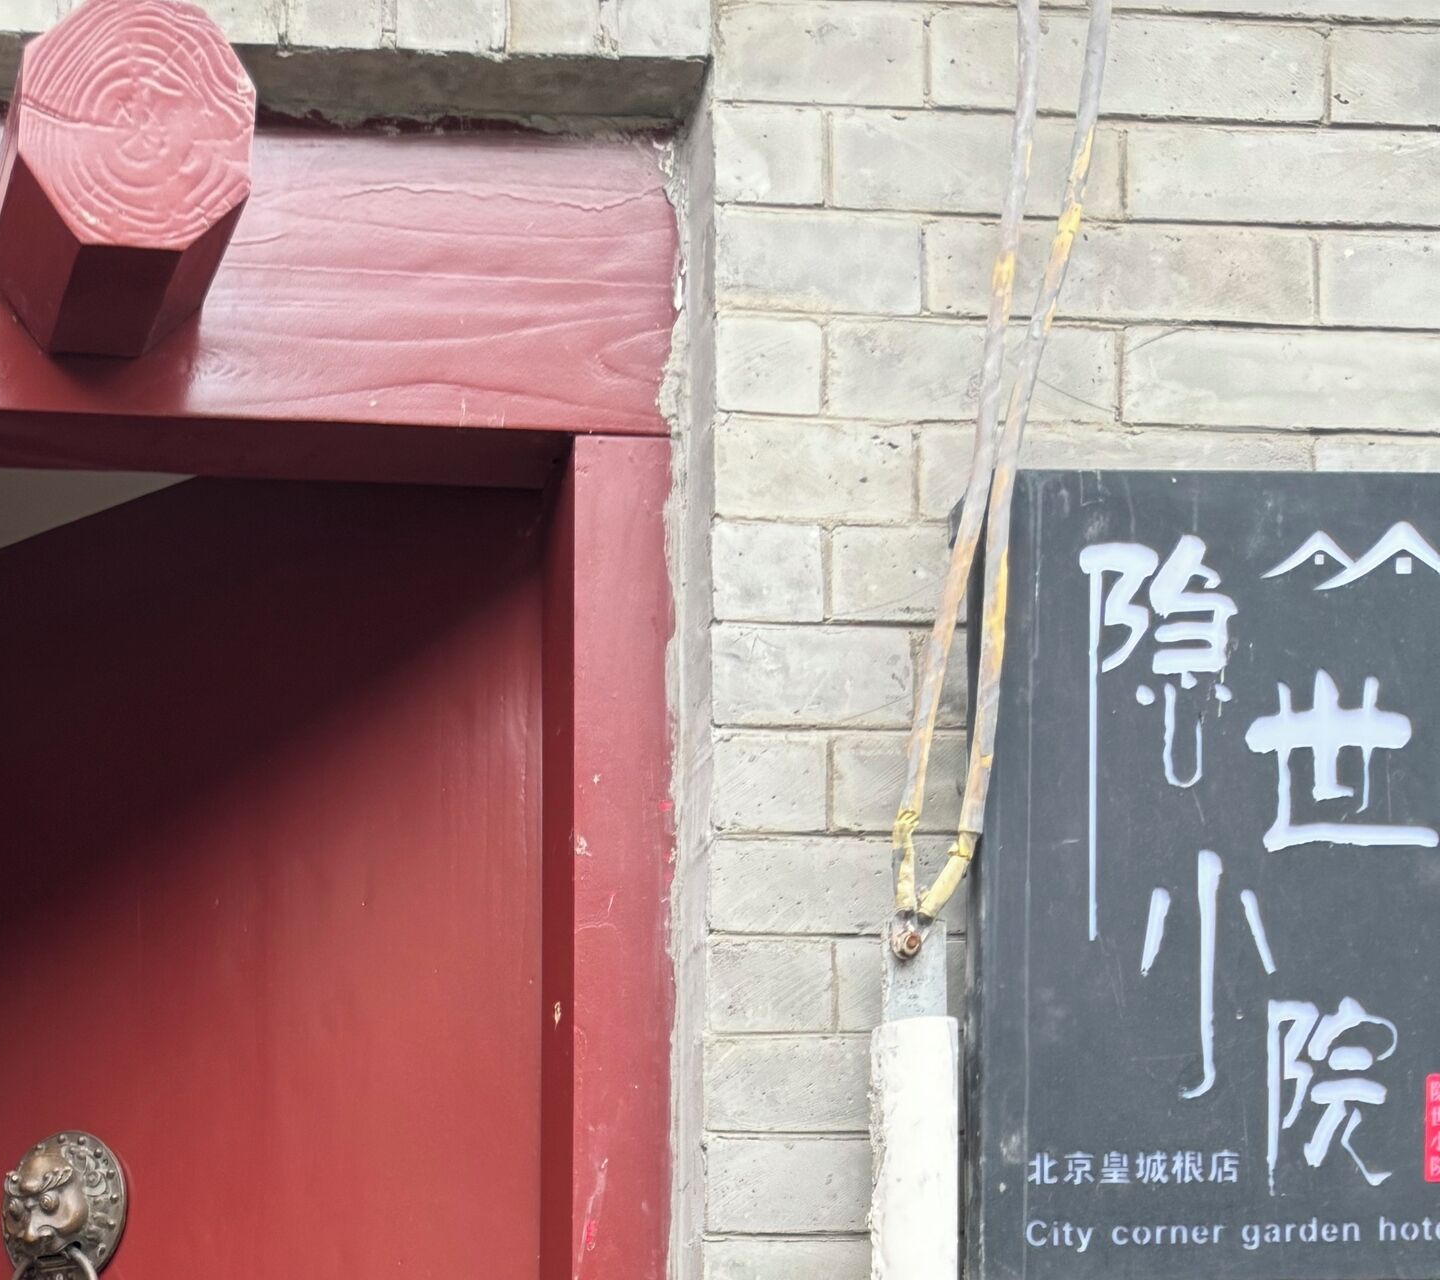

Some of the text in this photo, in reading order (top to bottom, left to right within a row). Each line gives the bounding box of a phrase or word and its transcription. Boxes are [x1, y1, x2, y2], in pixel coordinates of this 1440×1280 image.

[1027, 1150, 1240, 1186] 北京皇城根店
[1025, 1215, 1440, 1253] City corner garden hot
